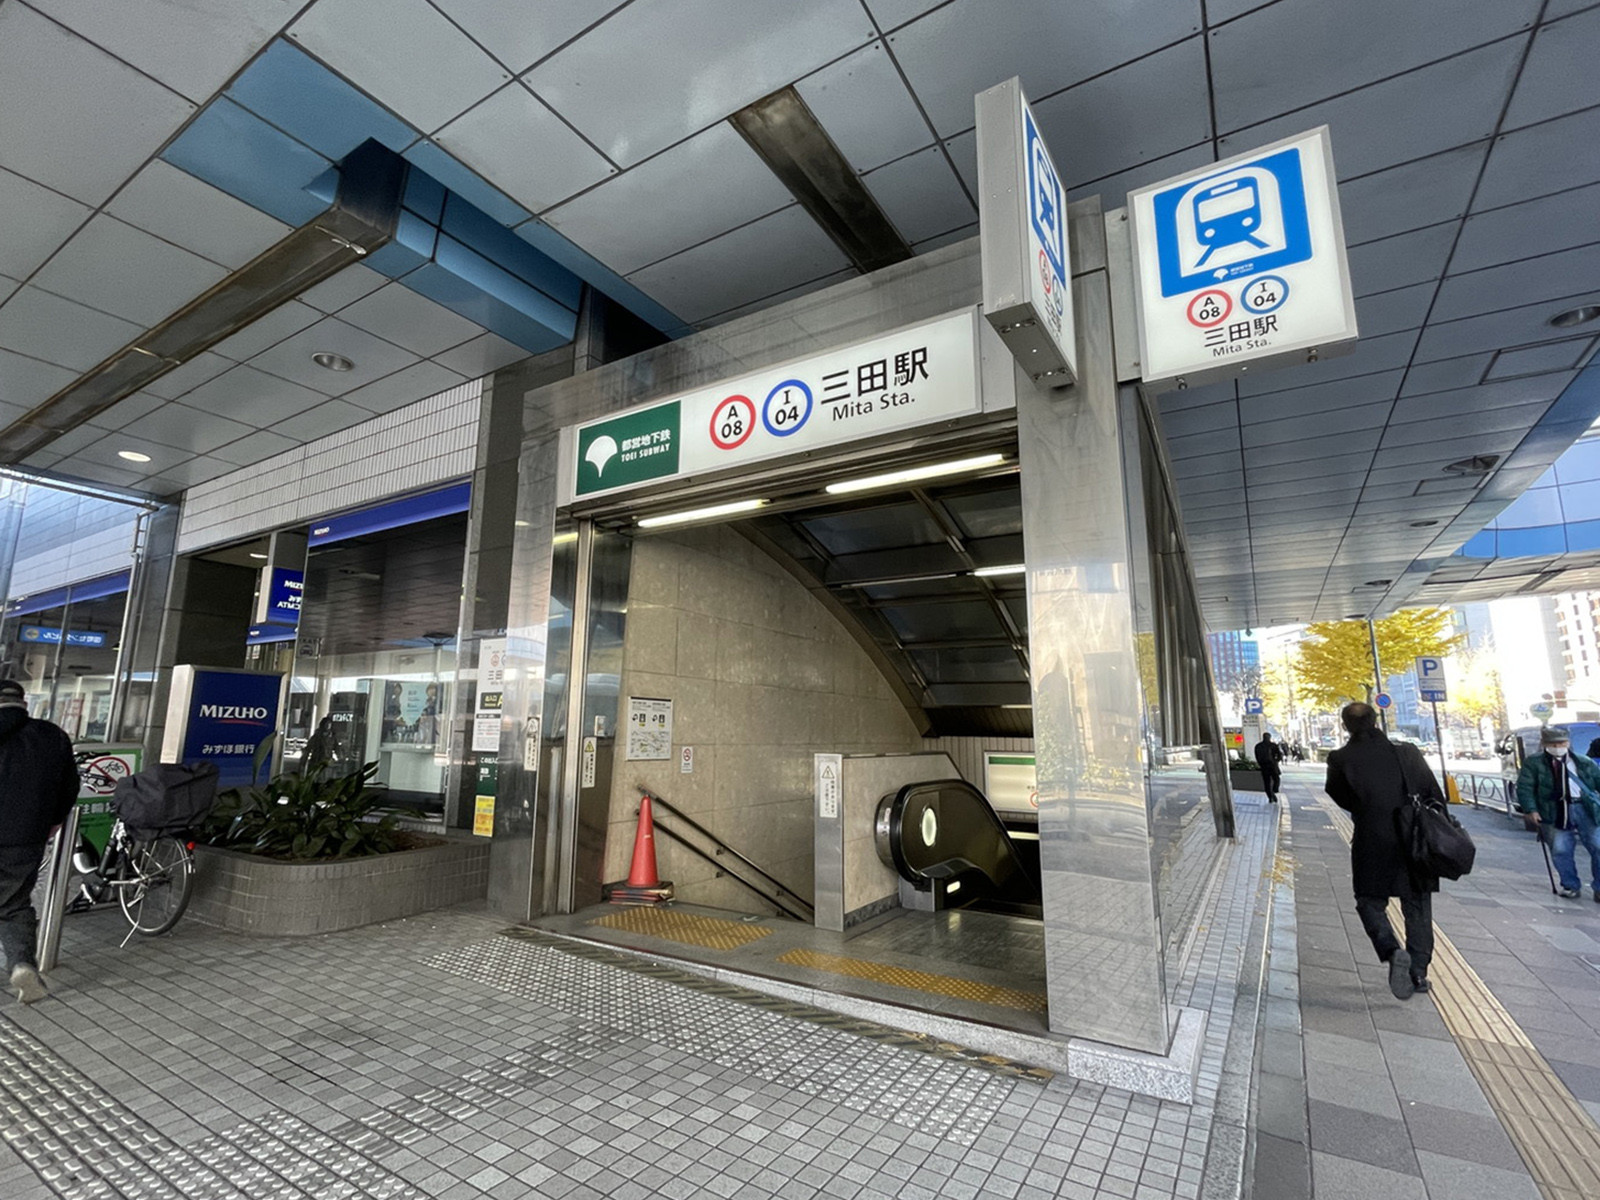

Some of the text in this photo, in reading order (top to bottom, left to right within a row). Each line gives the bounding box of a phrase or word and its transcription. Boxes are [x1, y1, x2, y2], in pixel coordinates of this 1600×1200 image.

[1260, 281, 1267, 293] I
[1203, 296, 1215, 307] A
[1253, 292, 1277, 307] 04
[1199, 306, 1220, 320] 08
[1204, 314, 1278, 347] 三田駅
[1213, 338, 1272, 357] Mita Sta.
[821, 346, 929, 405] 三田駅
[783, 389, 791, 405] I
[727, 404, 738, 420] A
[832, 392, 915, 421] Mita Sta.
[775, 405, 799, 425] 04
[721, 420, 743, 439] 08
[621, 443, 670, 462] TOEI SUBWAY
[1422, 659, 1438, 676] P
[199, 705, 268, 719] MIZUHO
[1248, 700, 1260, 712] P
[202, 744, 255, 754] みずほ銀行
